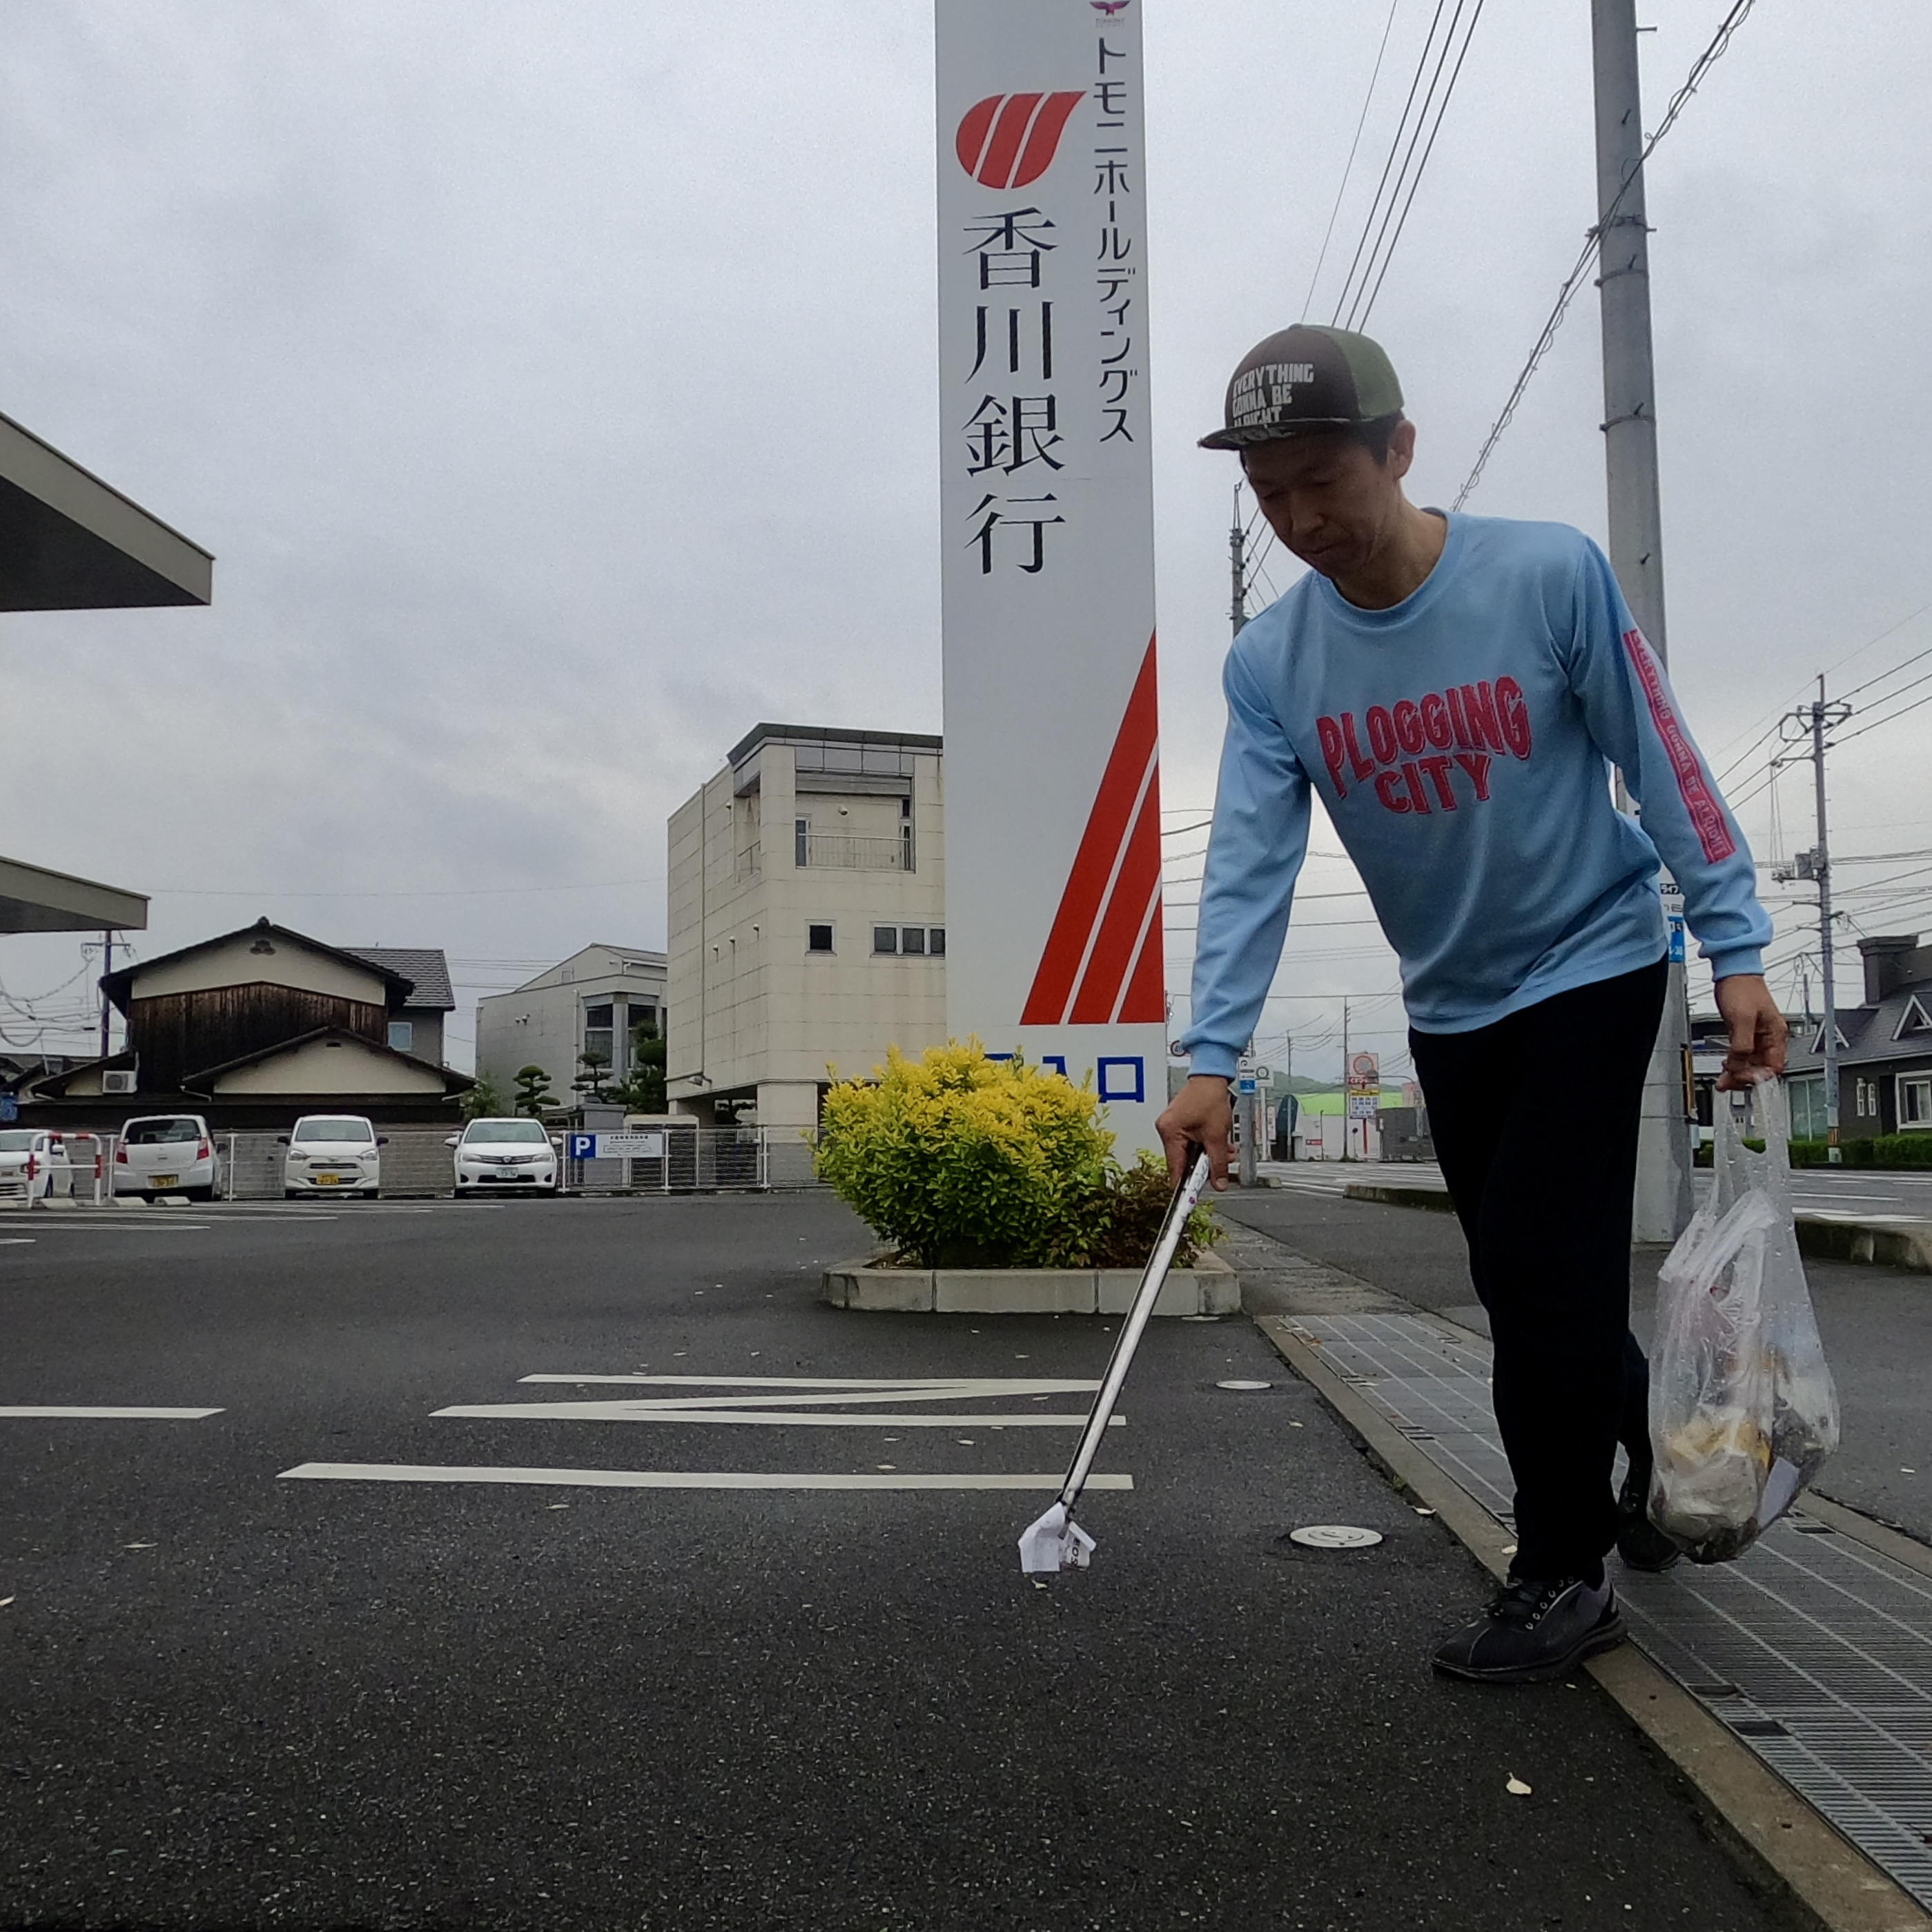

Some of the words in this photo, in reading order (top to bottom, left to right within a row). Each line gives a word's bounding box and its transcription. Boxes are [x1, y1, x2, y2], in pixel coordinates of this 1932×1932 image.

[1093, 37, 1138, 442] トモニホールディングス
[961, 206, 1066, 574] 香川銀行
[1232, 388, 1267, 418] GONNA
[1271, 384, 1293, 405] BE
[1233, 363, 1314, 399] EVERYTHING
[1316, 675, 1532, 800] PLOGGING
[1374, 753, 1492, 814] CITY
[1666, 723, 1690, 773] GONNA
[1684, 774, 1701, 793] BE
[1694, 798, 1728, 857] ALRIGHT
[576, 1136, 591, 1156] P
